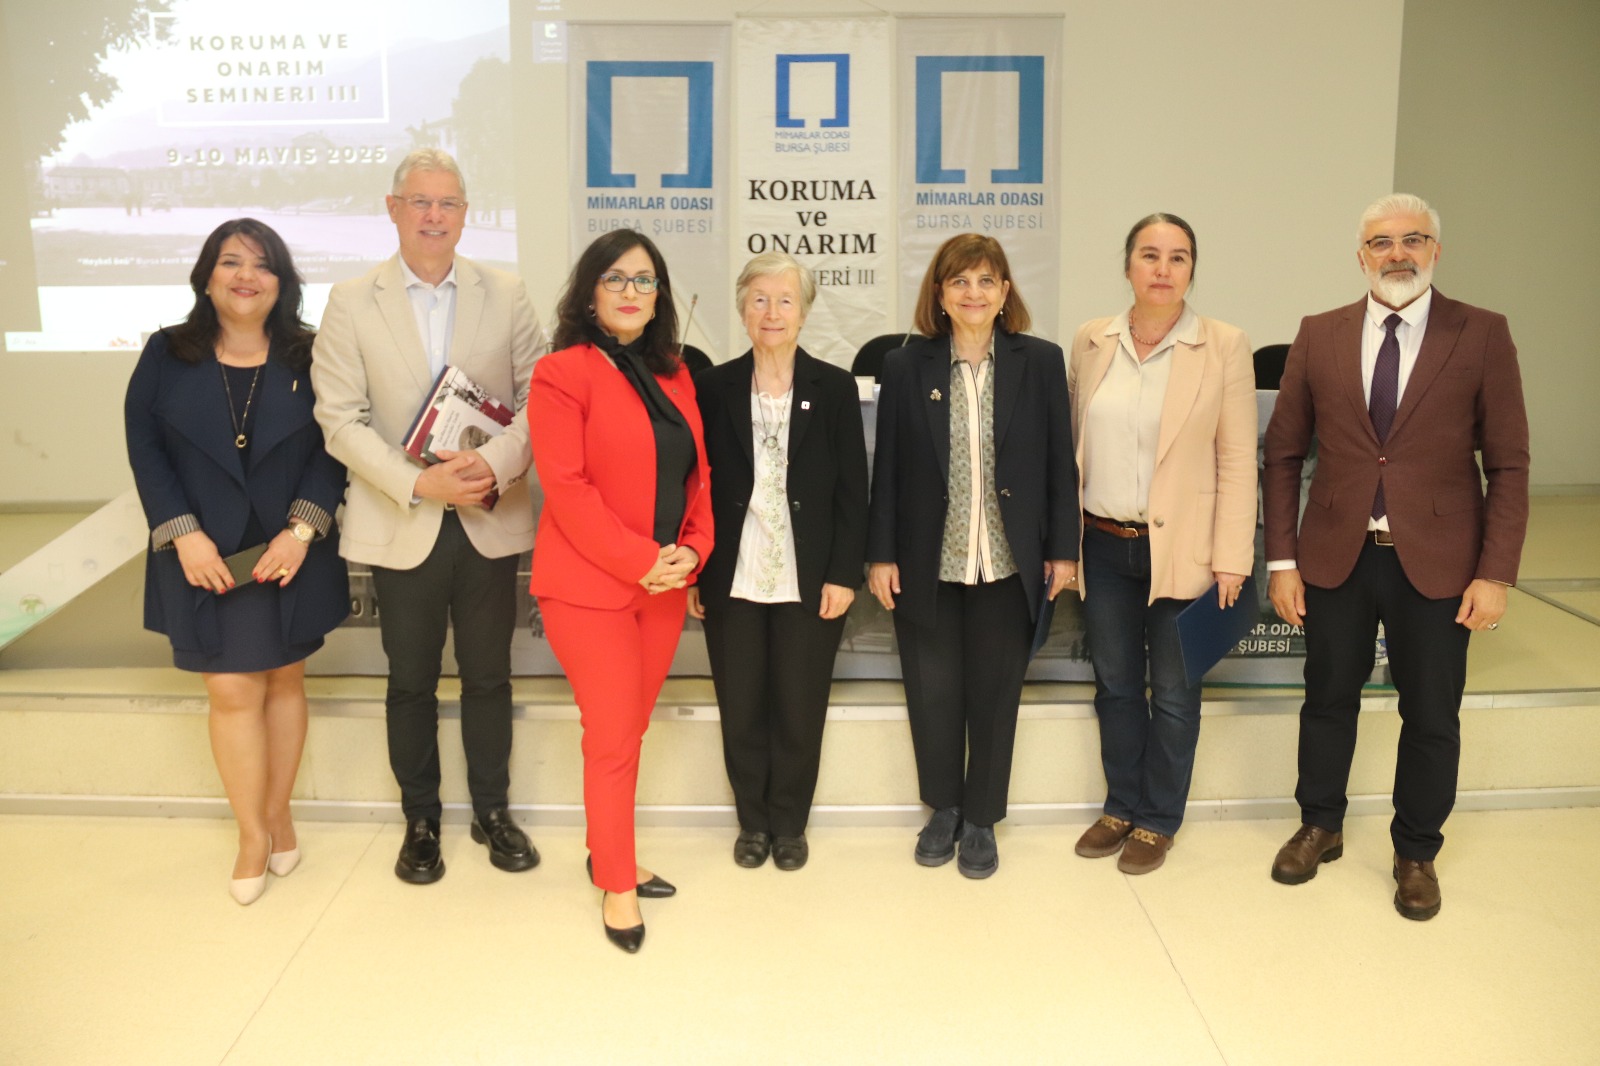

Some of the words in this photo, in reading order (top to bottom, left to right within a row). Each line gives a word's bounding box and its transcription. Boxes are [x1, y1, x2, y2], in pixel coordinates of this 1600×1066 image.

[189, 34, 306, 51] KORUMA
[318, 33, 349, 50] VE
[217, 60, 324, 77] ONARIM
[327, 85, 359, 102] III
[822, 131, 850, 139] ODASI
[775, 142, 811, 152] BURSA
[166, 148, 224, 166] 9-10
[234, 147, 317, 166] MAYIS
[327, 146, 388, 164] 2025
[748, 179, 877, 201] KORUMA
[916, 189, 995, 206] MİMARLAR
[1000, 192, 1044, 206] ODASI
[587, 193, 665, 210] MİMARLAR
[670, 197, 713, 210] ODASI
[587, 218, 643, 233] BURSA
[652, 216, 713, 235] ŞUBESİ
[796, 210, 828, 227] ve
[916, 214, 973, 229] BURSA
[982, 212, 1043, 231] ŞUBESİ
[747, 233, 877, 255] ONARIM
[857, 269, 875, 285] III
[1270, 624, 1305, 636] ODA
[1238, 638, 1290, 655] ŞUBESİ
